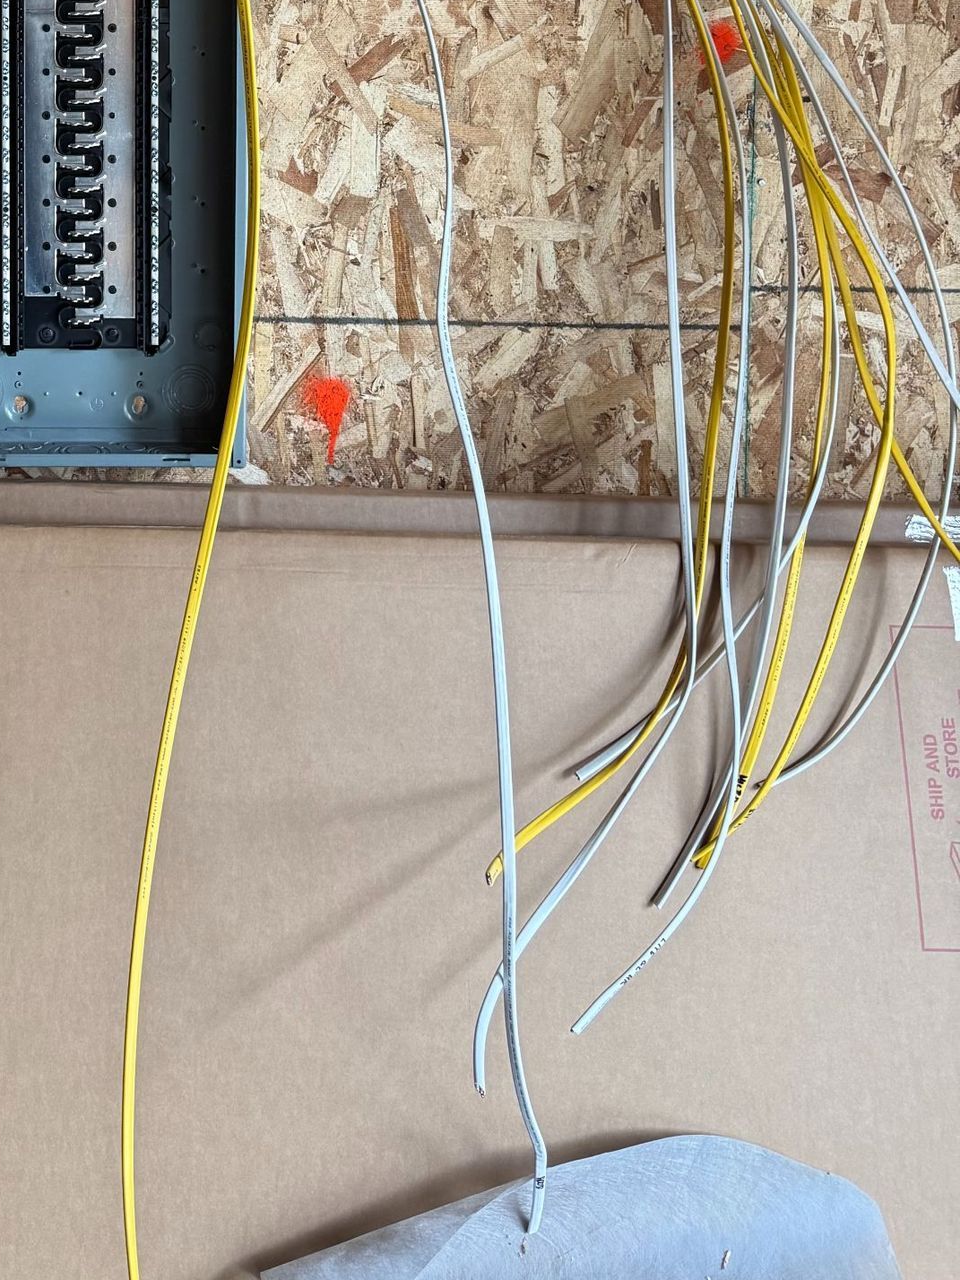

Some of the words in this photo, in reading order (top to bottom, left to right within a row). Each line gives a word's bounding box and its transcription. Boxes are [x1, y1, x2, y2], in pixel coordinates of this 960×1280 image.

[923, 734, 940, 772] AND
[941, 717, 960, 779] STORE
[928, 779, 945, 820] SHIP
